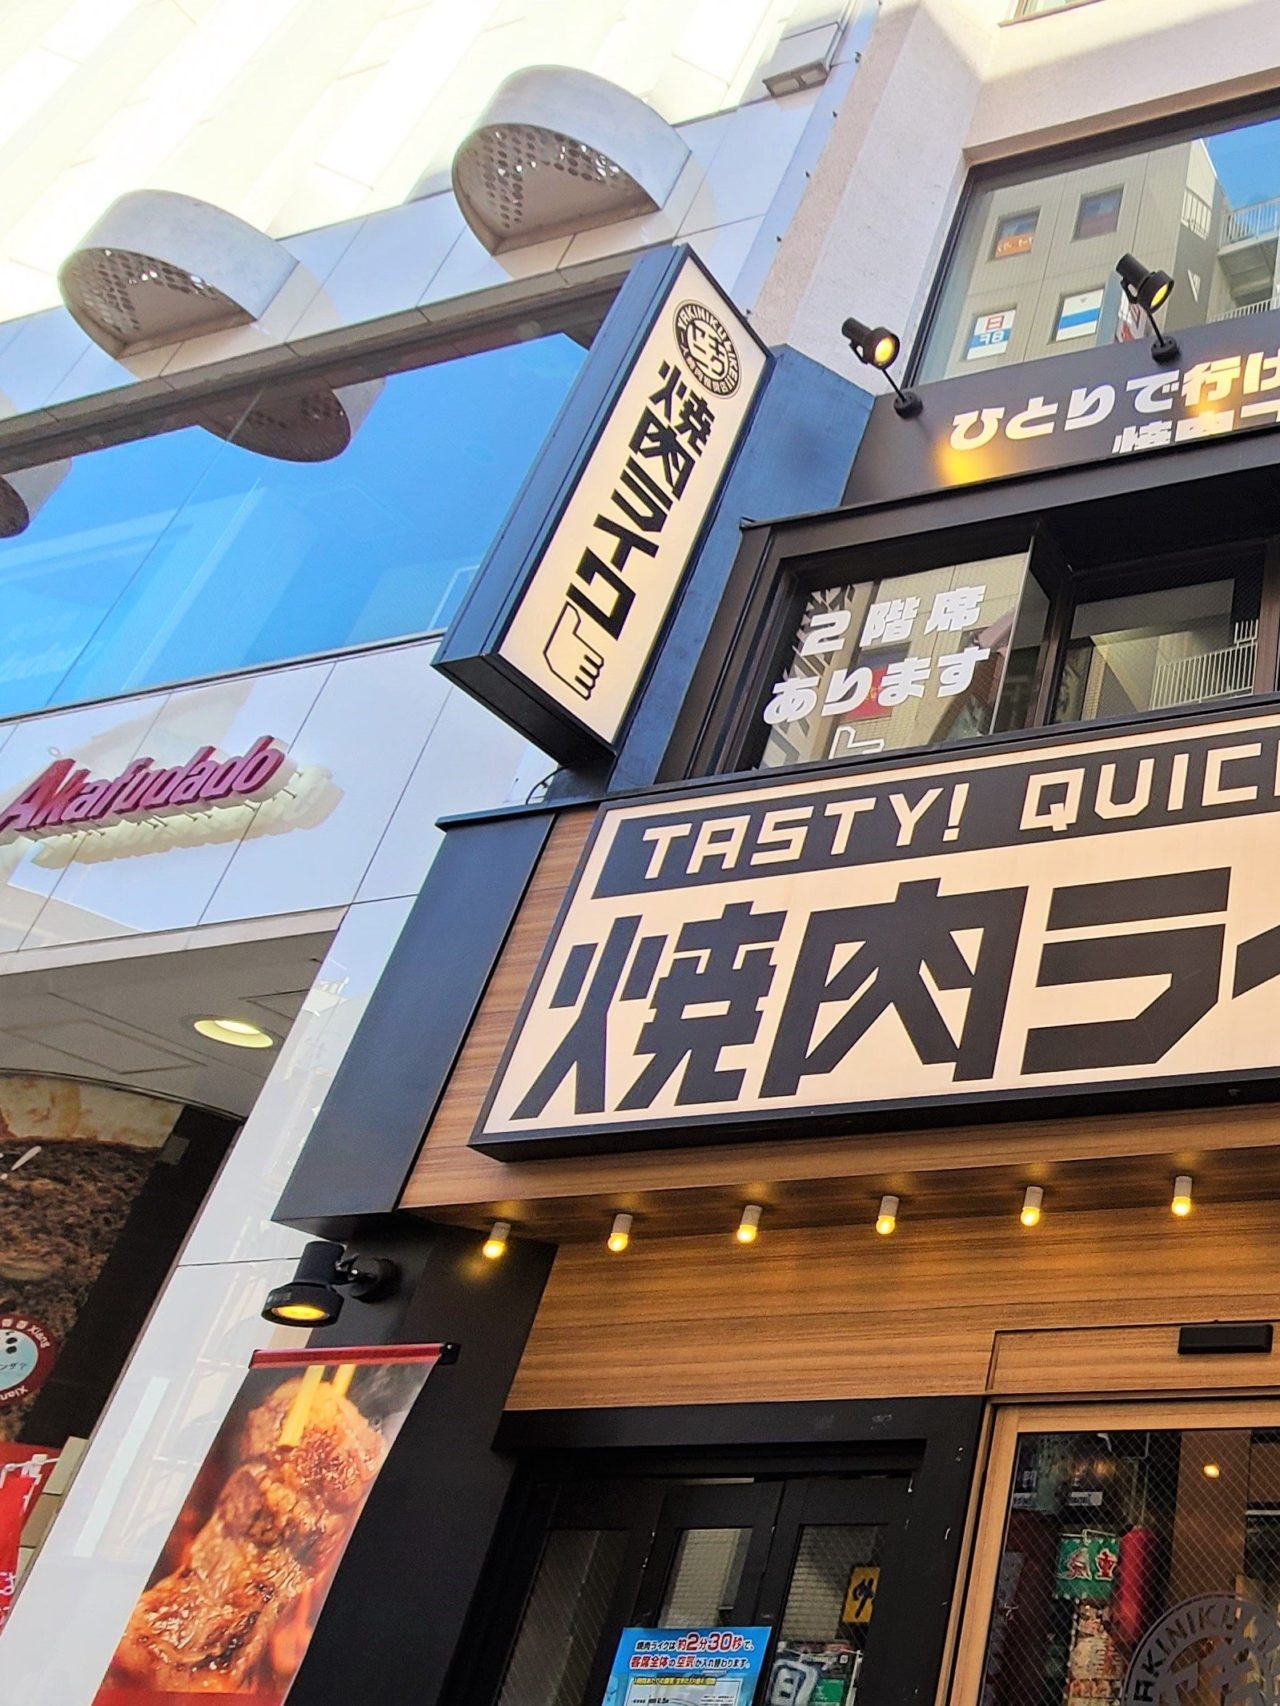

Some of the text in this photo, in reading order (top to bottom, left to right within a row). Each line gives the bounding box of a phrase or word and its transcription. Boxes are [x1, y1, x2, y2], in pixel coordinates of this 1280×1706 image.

[566, 360, 715, 641] 焼肉ライク
[800, 585, 987, 657] 2階席
[763, 646, 990, 725] あります
[0, 735, 285, 832] Akafudado
[641, 783, 969, 881] TASTY!
